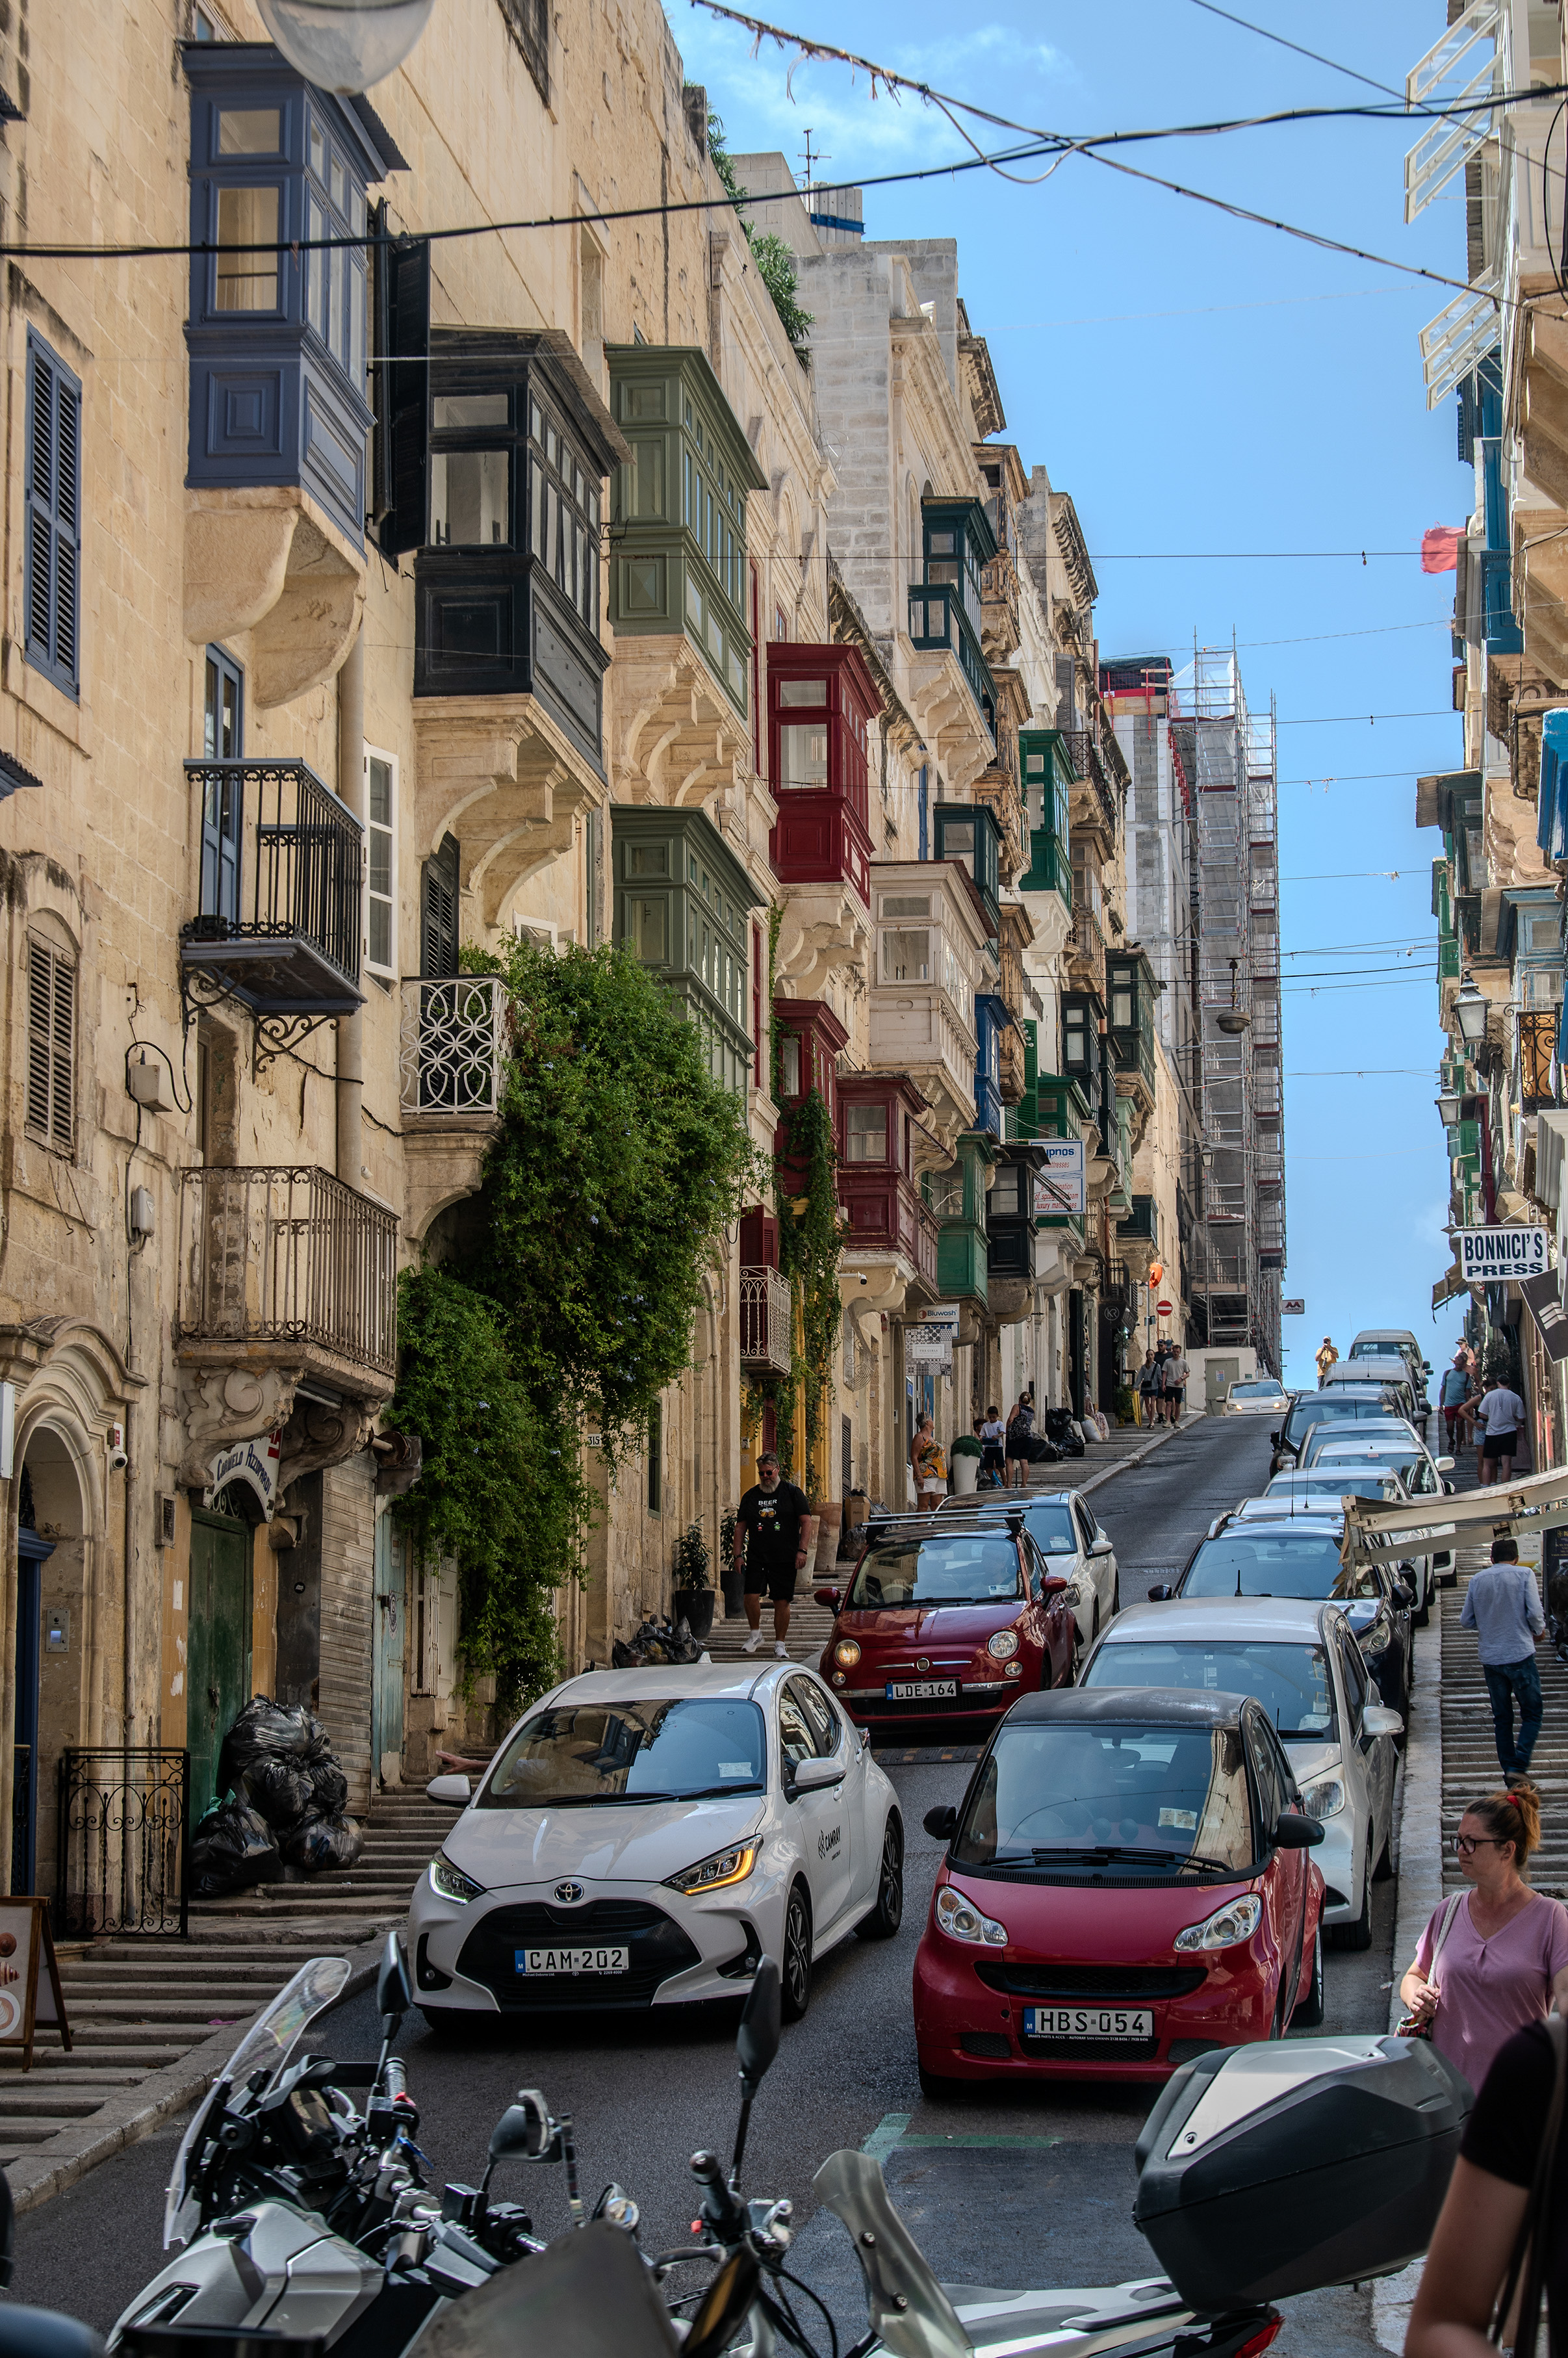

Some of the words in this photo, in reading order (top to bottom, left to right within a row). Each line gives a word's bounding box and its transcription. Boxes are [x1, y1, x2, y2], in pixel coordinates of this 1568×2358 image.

[1046, 1148, 1074, 1158] pnos
[1464, 1232, 1543, 1261] BONNICI'S
[1467, 1262, 1543, 1277] PRESS
[587, 1436, 600, 1445] 315
[896, 1685, 923, 1698] LDE
[929, 1683, 955, 1696] 164
[530, 1950, 572, 1970] CAM
[582, 1949, 623, 1969] 202
[1040, 2011, 1088, 2032] HBS
[1099, 2012, 1144, 2034] 054
